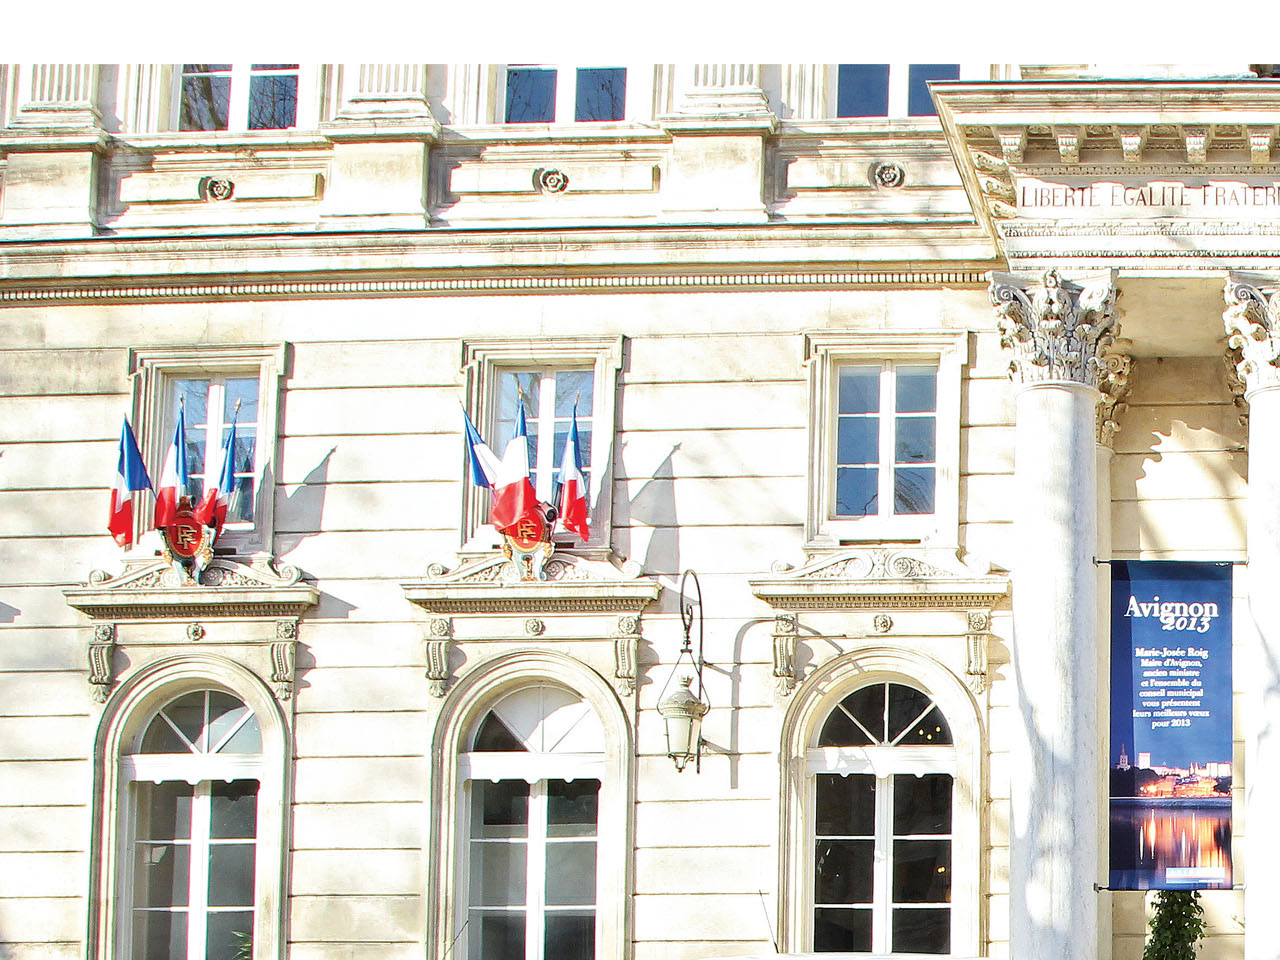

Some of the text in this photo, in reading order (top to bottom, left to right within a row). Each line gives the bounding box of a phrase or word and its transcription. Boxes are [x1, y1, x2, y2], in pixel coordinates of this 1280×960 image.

[1124, 595, 1220, 624] Avignon
[1161, 616, 1211, 633] 2013
[1187, 648, 1209, 659] Roig
[1141, 679, 1149, 687] et
[1139, 688, 1204, 699] conseil municipal
[1133, 709, 1151, 717] leurs
[1153, 709, 1187, 717] meilleurs
[1152, 719, 1191, 729] pour 2013
